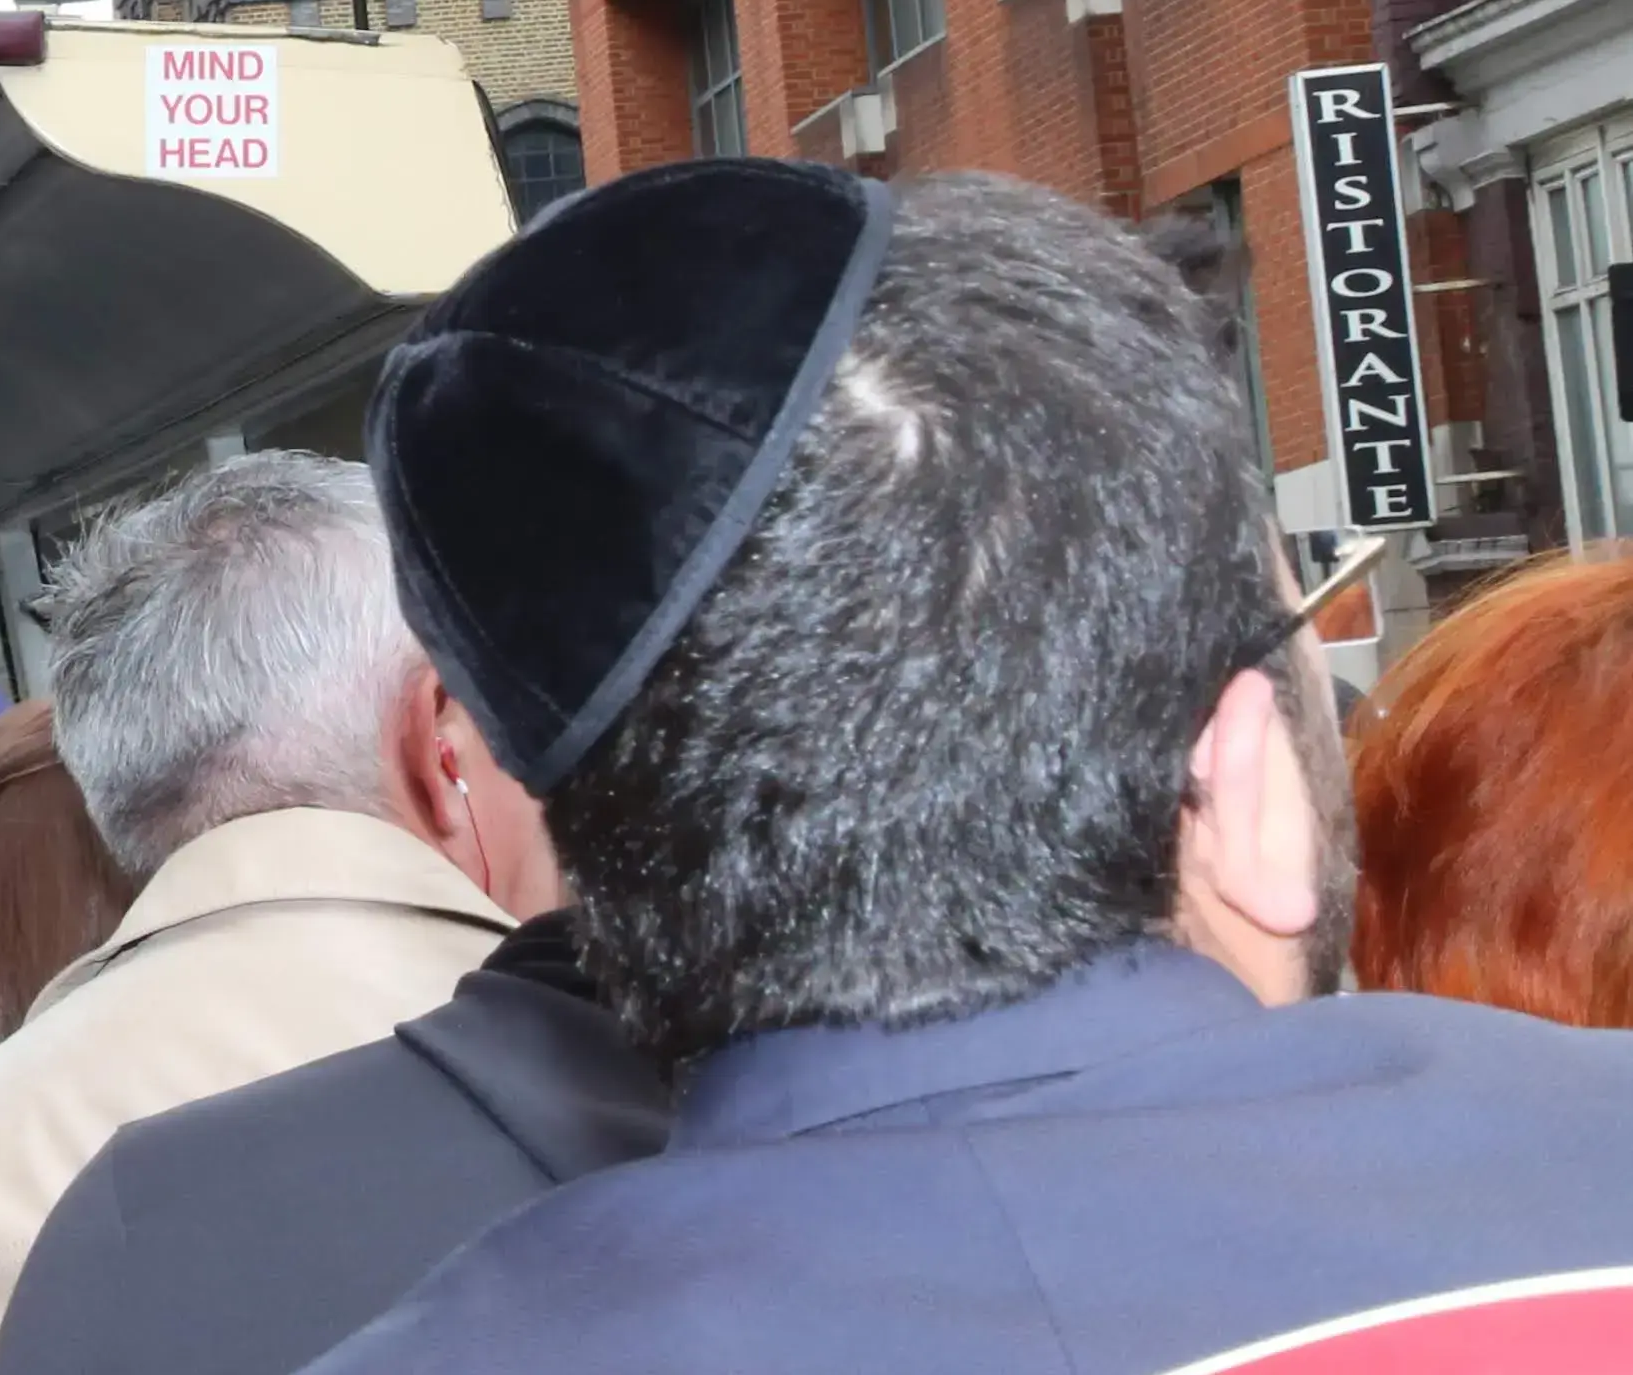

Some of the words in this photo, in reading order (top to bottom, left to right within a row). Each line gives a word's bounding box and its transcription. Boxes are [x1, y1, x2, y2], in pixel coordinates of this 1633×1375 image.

[163, 51, 264, 80] MIND
[160, 94, 269, 125] YOUR
[160, 138, 268, 169] HEAD
[1312, 88, 1413, 520] RISTORANTE
